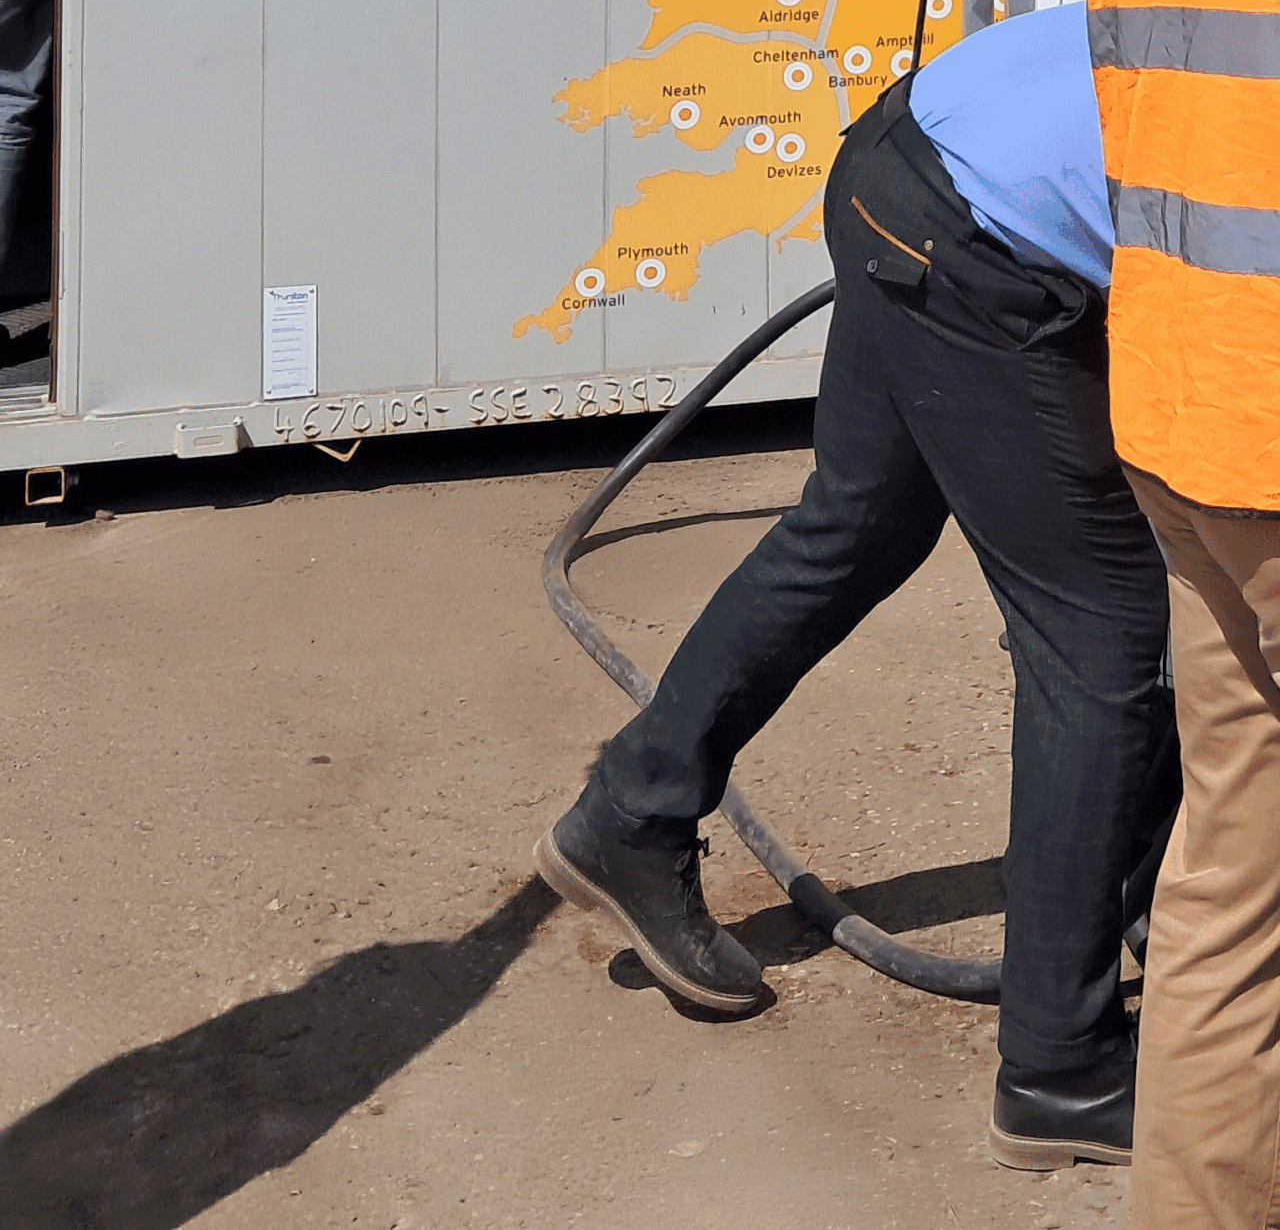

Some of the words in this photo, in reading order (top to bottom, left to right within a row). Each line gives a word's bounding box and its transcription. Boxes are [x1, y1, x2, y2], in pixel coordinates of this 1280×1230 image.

[759, 8, 820, 25] Aldridge
[875, 32, 935, 48] Amptill
[753, 48, 839, 63] Cheltenham
[828, 74, 888, 88] Banbury
[662, 84, 706, 97] Neath
[719, 111, 801, 127] Avonmouth
[766, 164, 822, 179] Devizes
[618, 242, 689, 259] Plymouth
[562, 294, 626, 310] Cornwall
